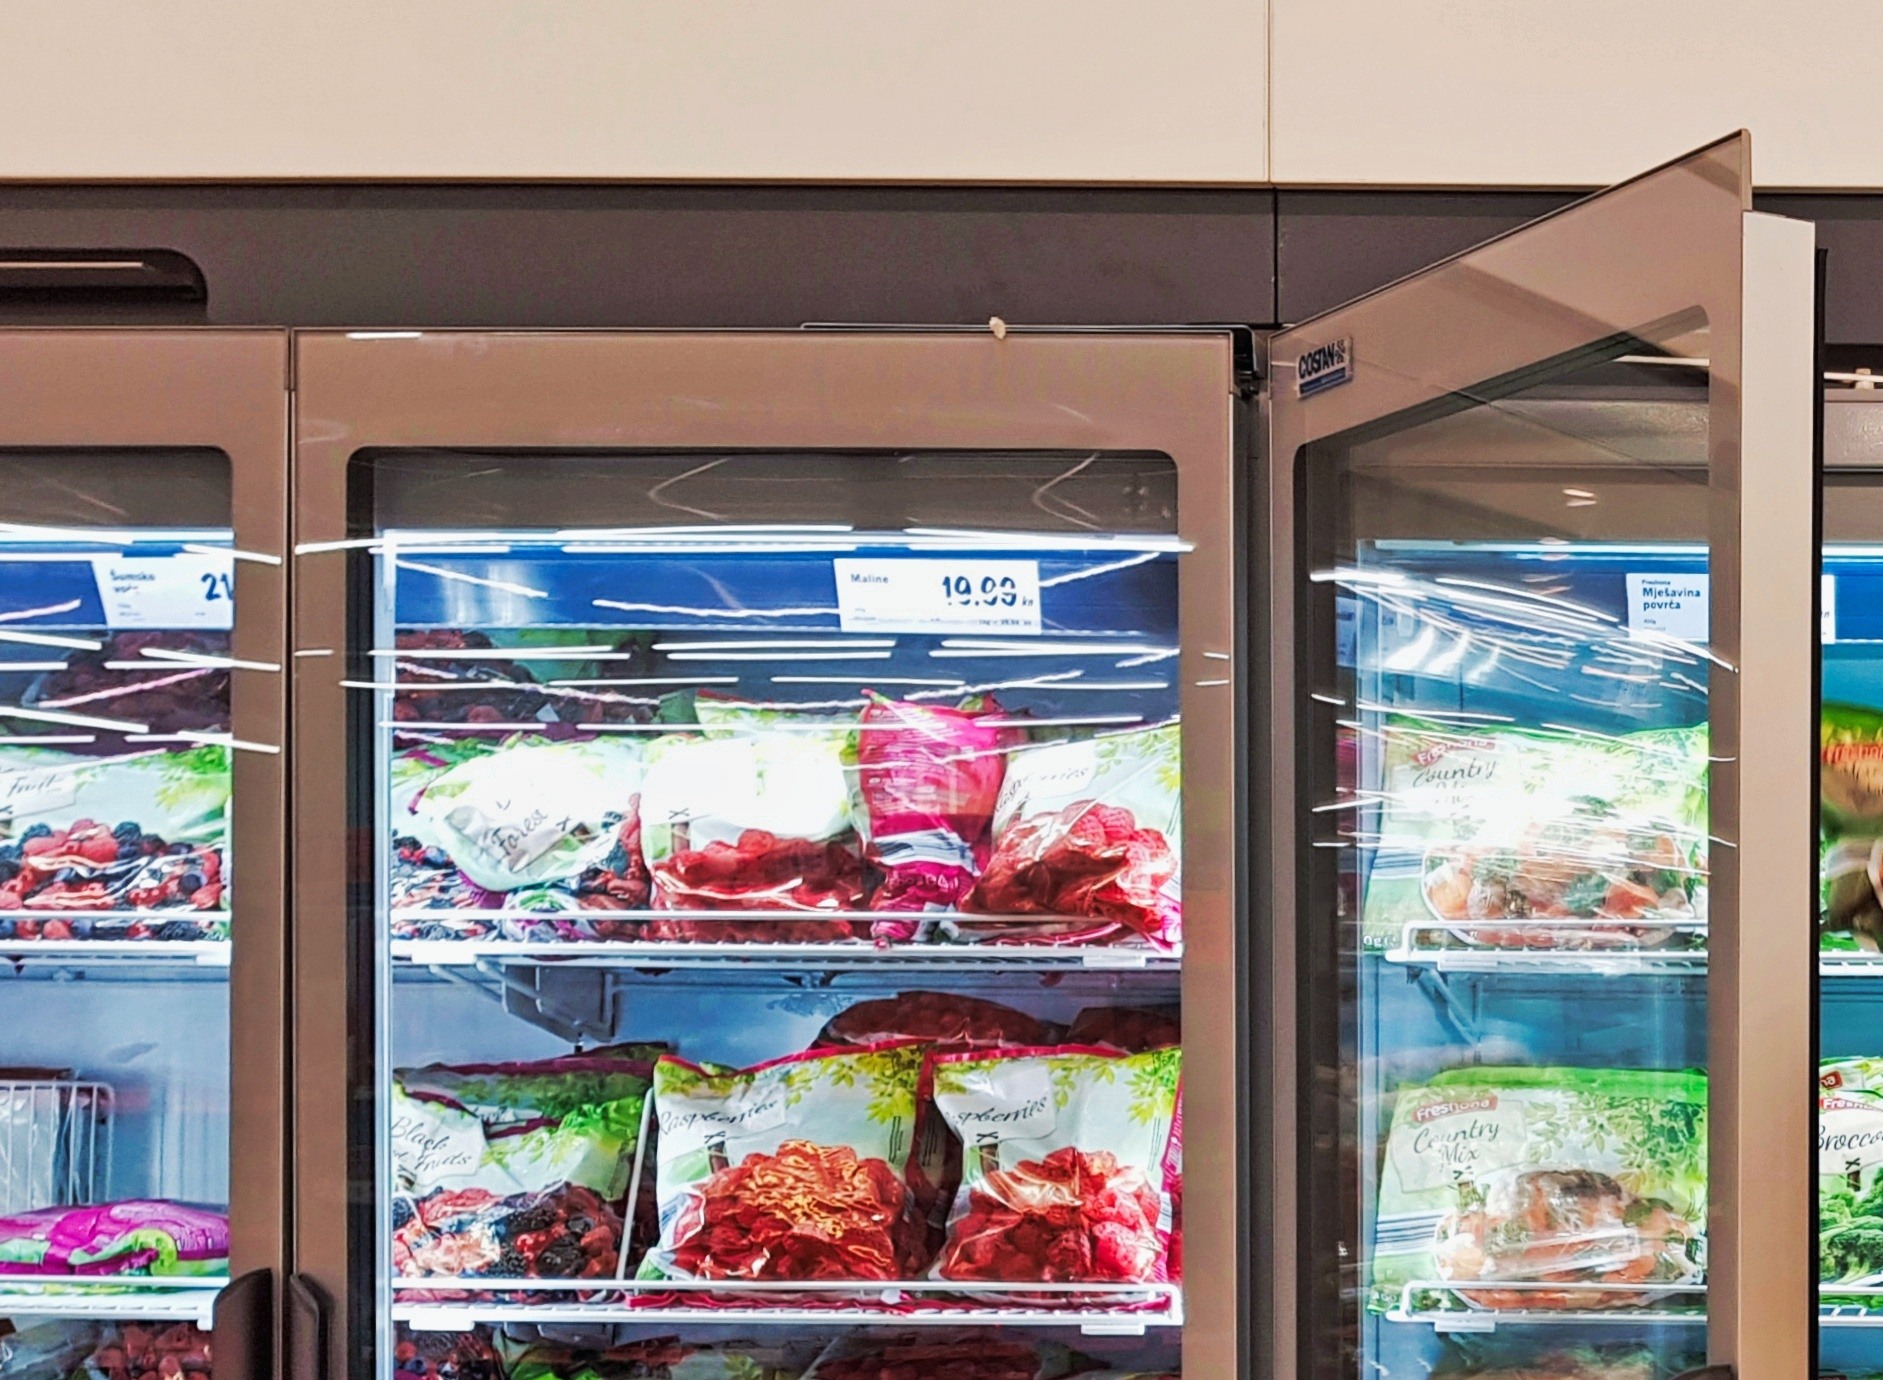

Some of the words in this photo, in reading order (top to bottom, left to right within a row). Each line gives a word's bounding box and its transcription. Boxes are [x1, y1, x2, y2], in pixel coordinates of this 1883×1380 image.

[850, 574, 889, 583] Maline
[1642, 587, 1701, 599] Mješavina
[1643, 600, 1681, 610] povrća
[1412, 757, 1497, 787] Country
[1416, 1099, 1491, 1121] Freshona
[1413, 1119, 1500, 1154] Country
[1438, 1143, 1481, 1170] Mix
